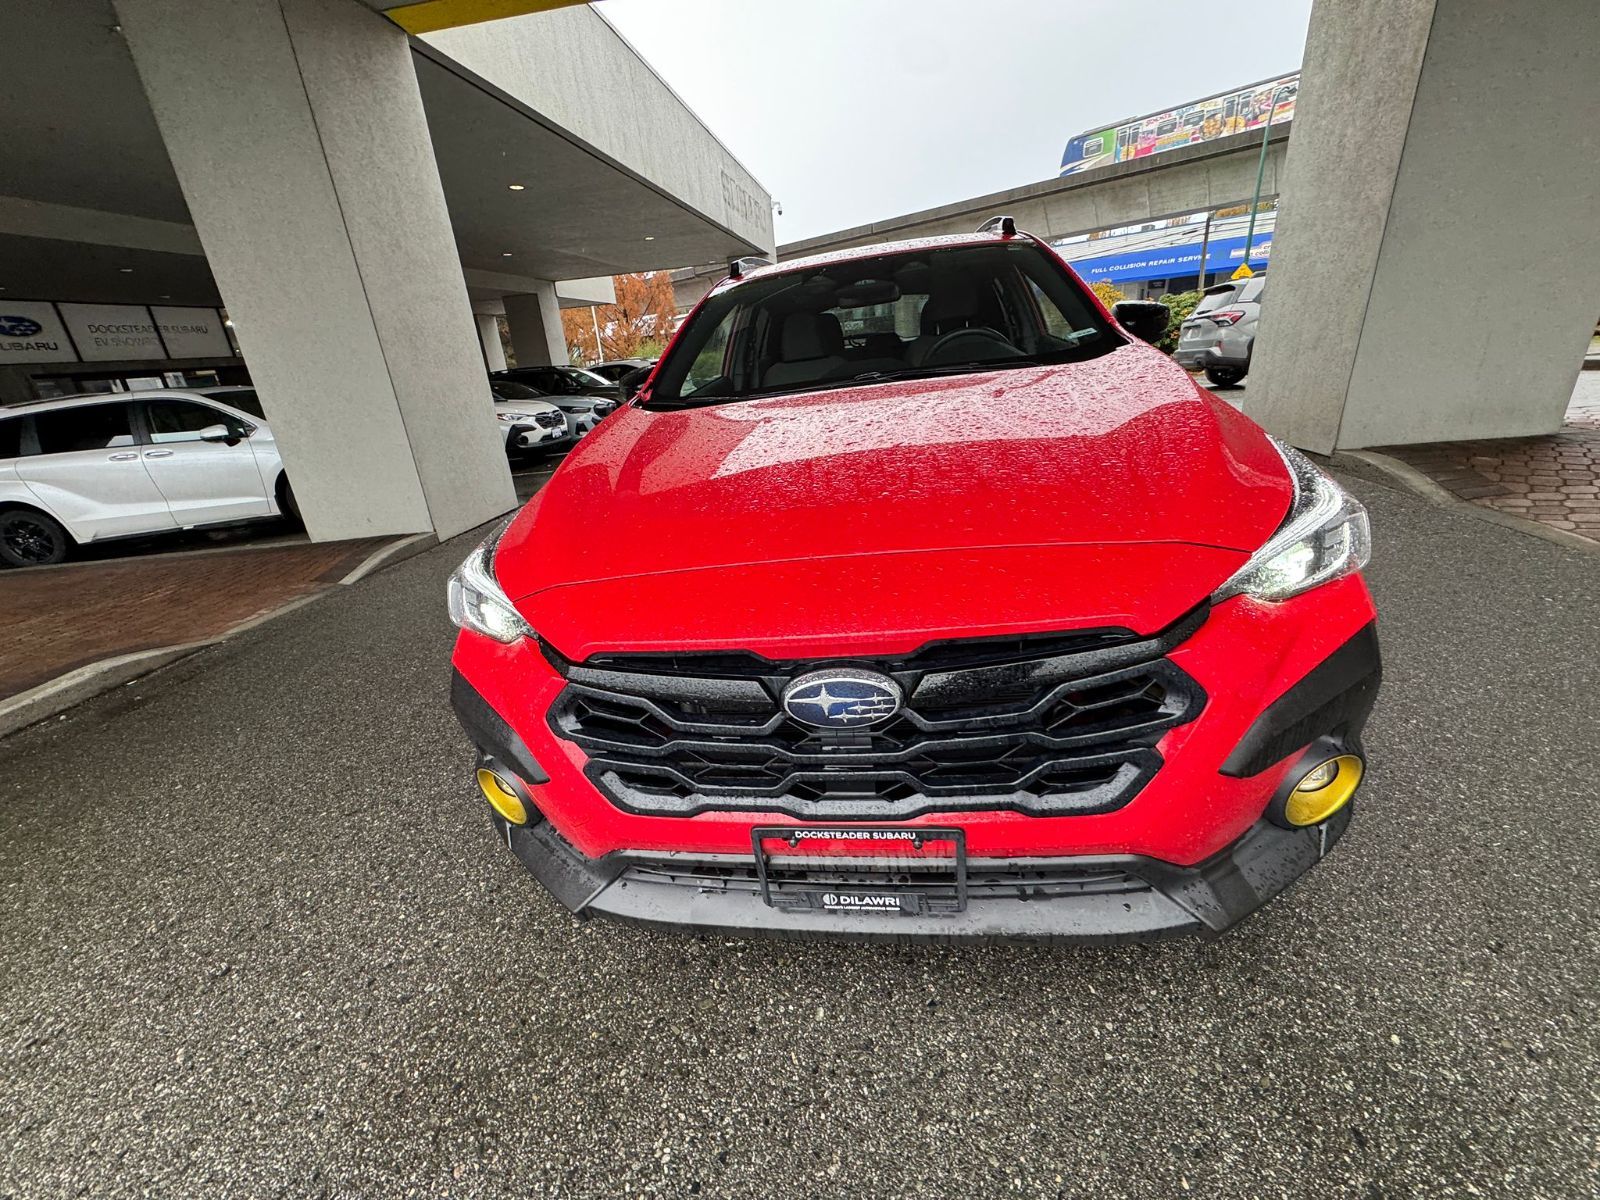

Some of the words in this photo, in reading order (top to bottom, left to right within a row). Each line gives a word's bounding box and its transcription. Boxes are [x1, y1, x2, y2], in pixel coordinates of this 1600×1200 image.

[1109, 262, 1146, 271] COLLISION
[1149, 257, 1175, 266] REPAIR
[1177, 253, 1211, 262] SERVIE
[170, 325, 208, 334] SUBARU
[0, 342, 58, 351] UBARU
[95, 337, 108, 347] EV
[795, 831, 870, 839] DOCKSTEADER
[839, 895, 900, 906] DILAWRI
